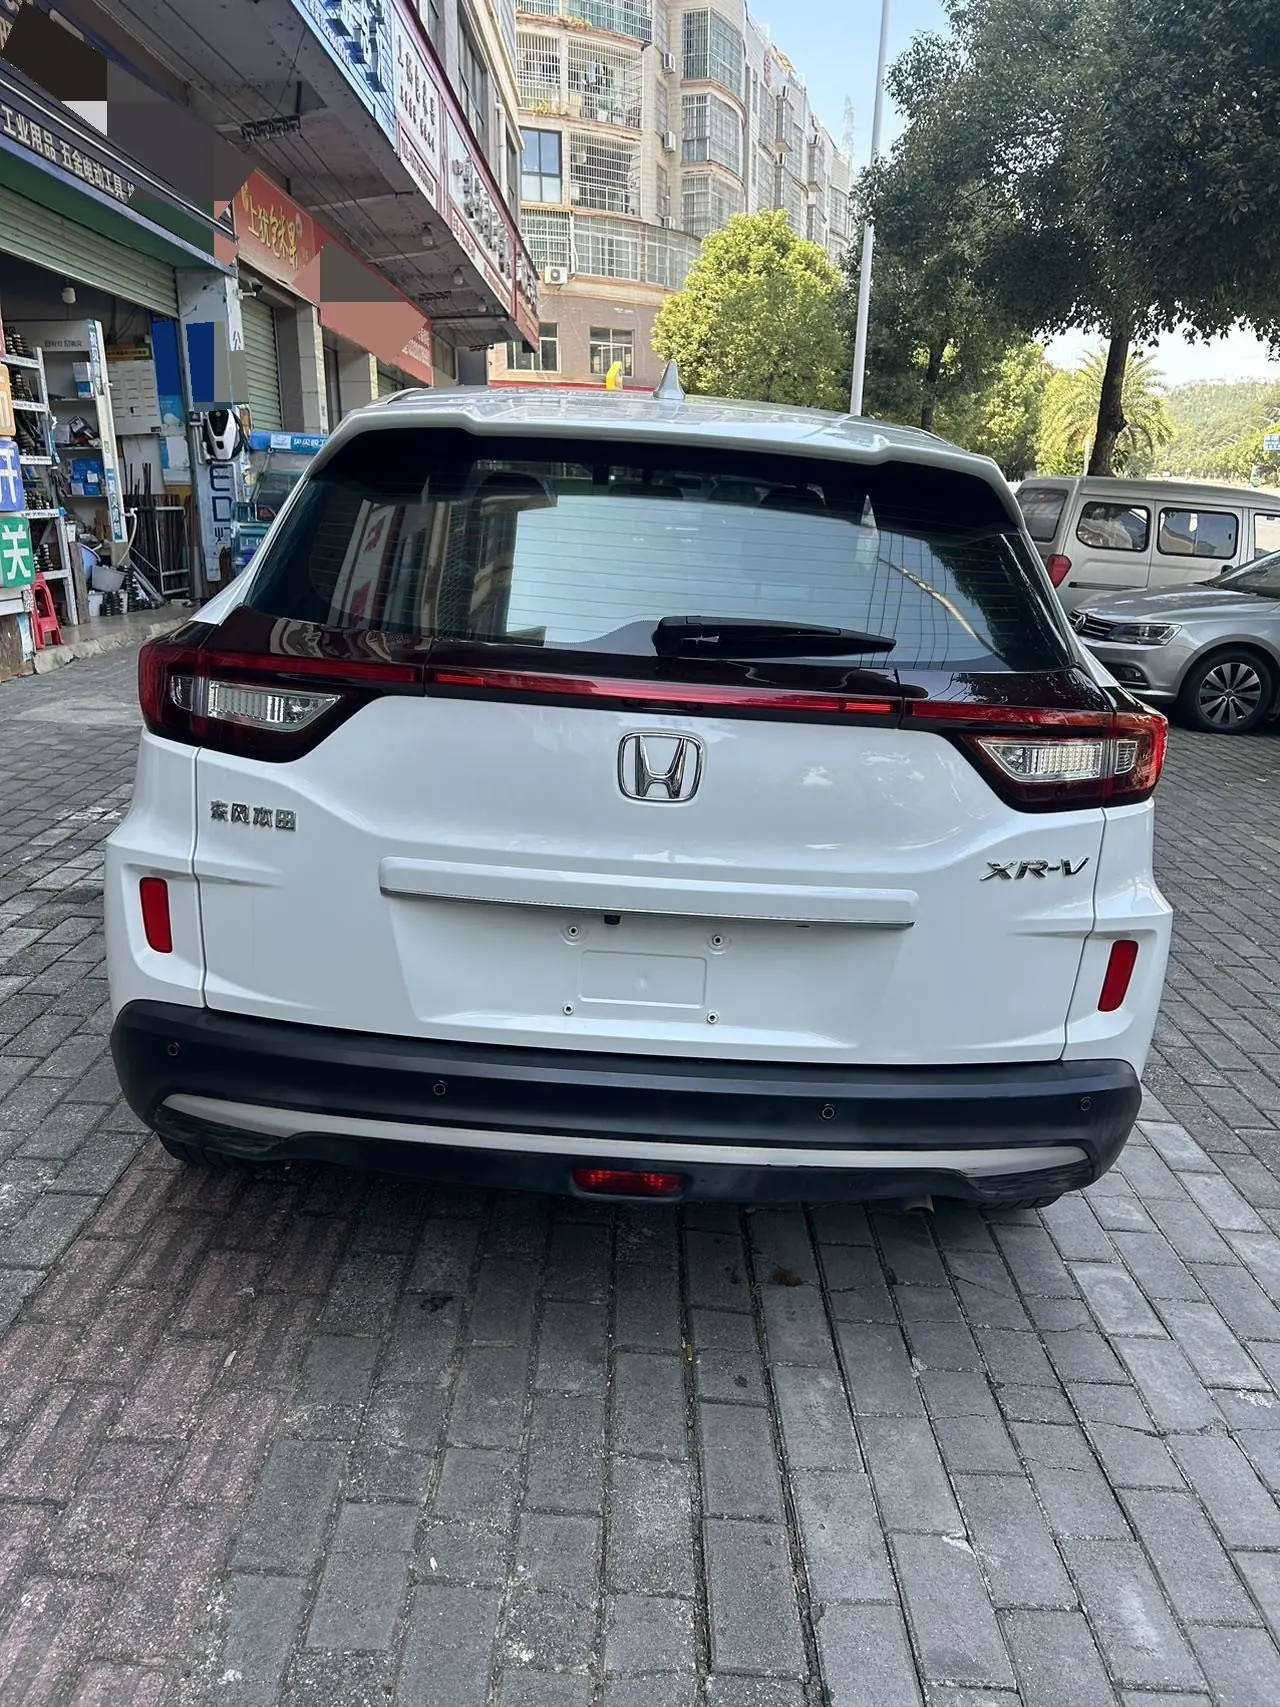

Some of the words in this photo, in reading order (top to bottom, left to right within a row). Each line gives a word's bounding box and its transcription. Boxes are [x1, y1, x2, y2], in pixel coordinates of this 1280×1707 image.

[1, 104, 57, 162] 工业用品
[1, 523, 32, 580] 关
[210, 799, 297, 832] 东风本田
[979, 857, 1090, 882] XR-V
